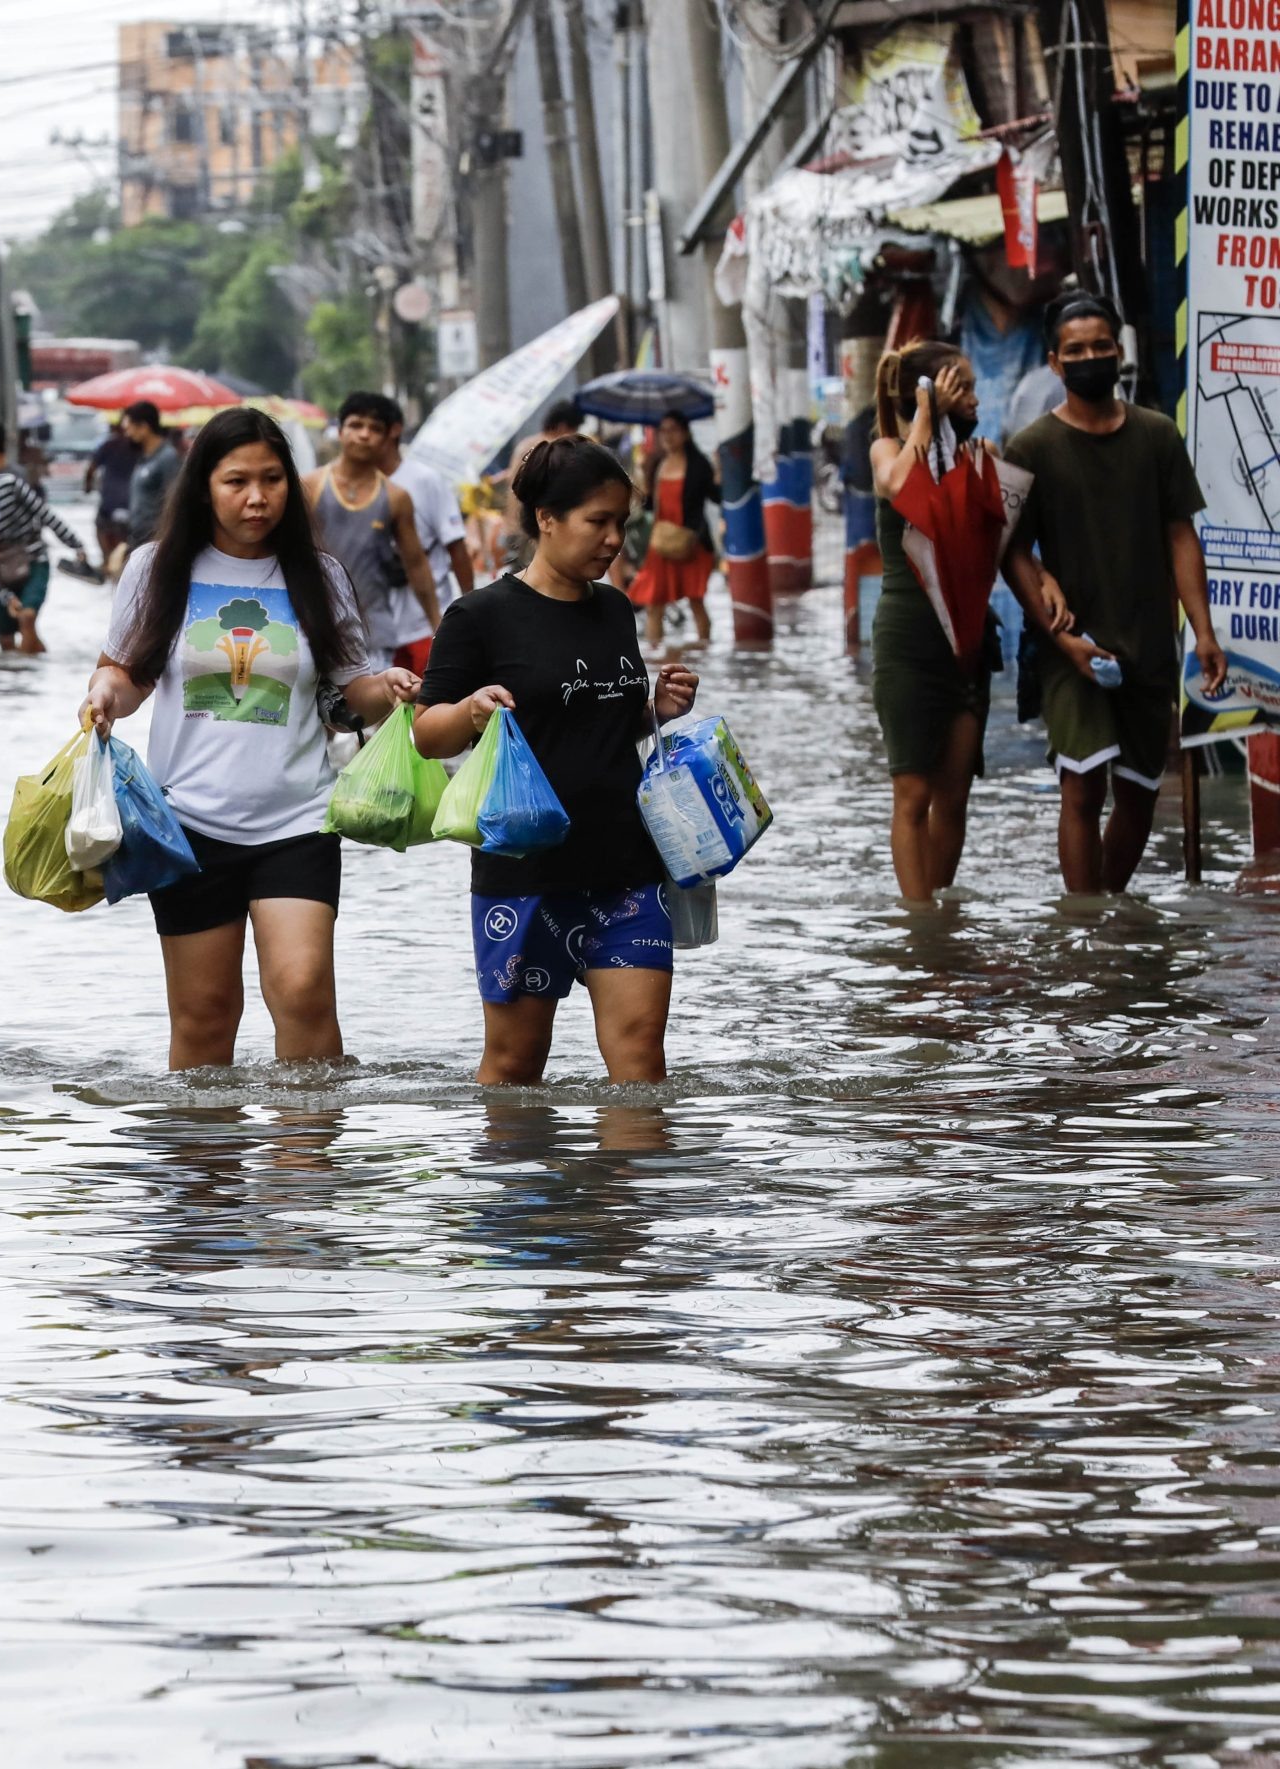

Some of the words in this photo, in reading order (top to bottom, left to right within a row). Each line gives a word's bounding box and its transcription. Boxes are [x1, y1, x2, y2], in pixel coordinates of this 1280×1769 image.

[1197, 0, 1280, 31] ALONG
[1195, 80, 1237, 111] DUE
[1243, 83, 1271, 112] TO
[1209, 158, 1236, 188] OF
[1241, 160, 1280, 191] DEP
[1194, 195, 1278, 229] WORKS
[1204, 528, 1246, 544] COMPLETED
[1208, 579, 1244, 606] RRY
[1231, 613, 1279, 641] DURI
[594, 681, 614, 692] my
